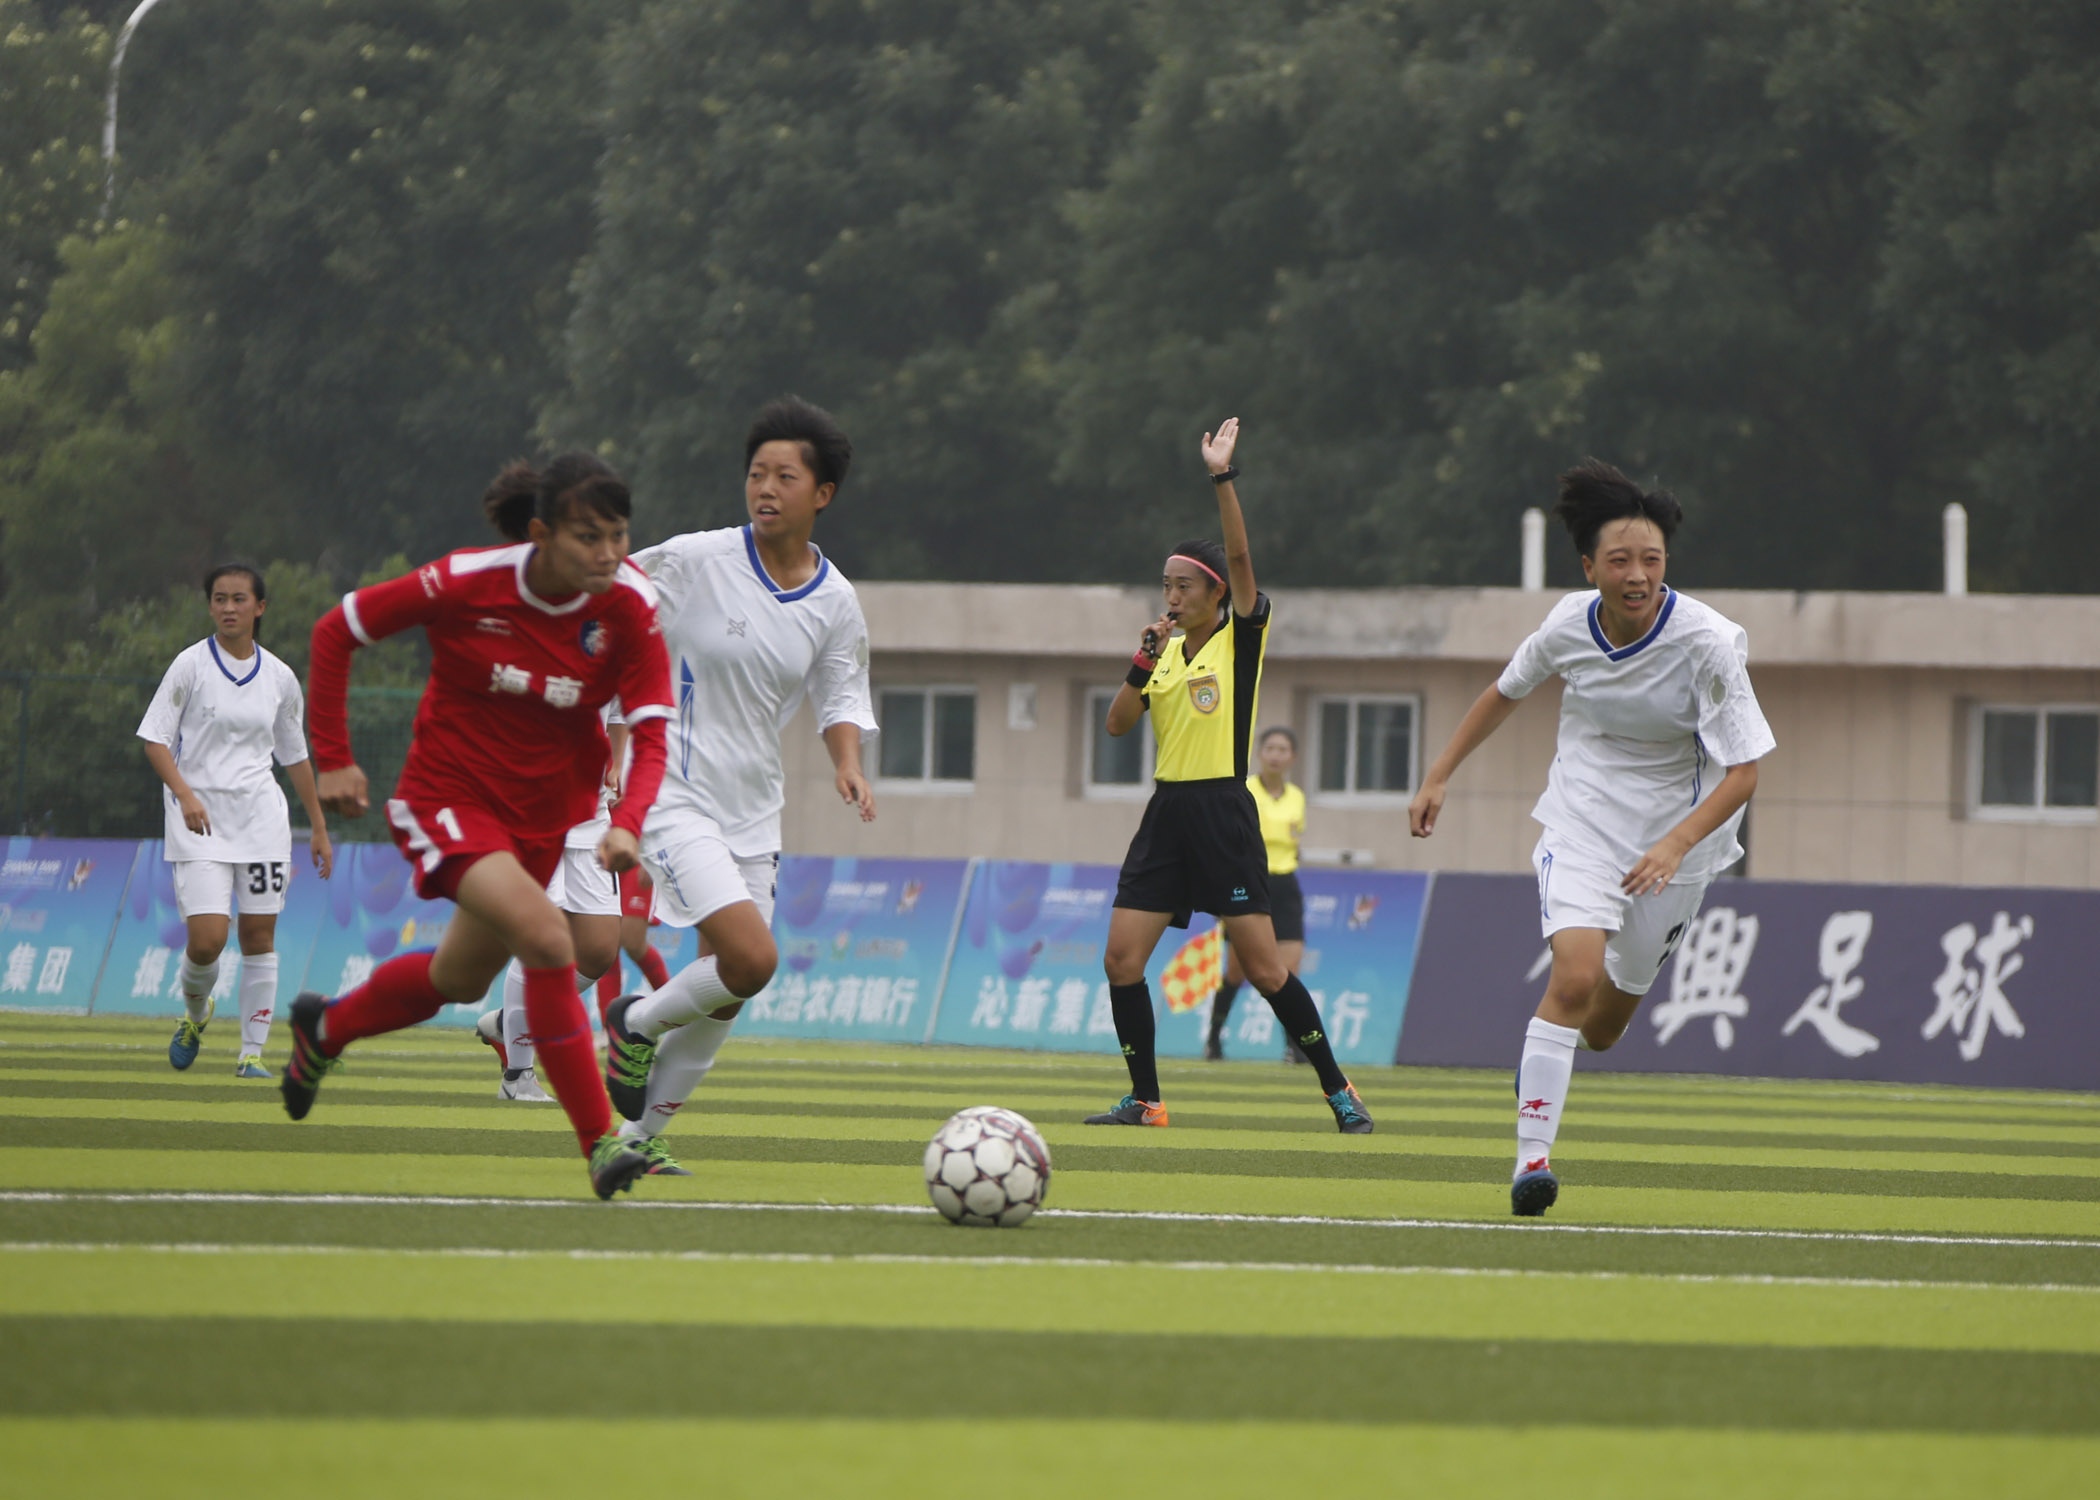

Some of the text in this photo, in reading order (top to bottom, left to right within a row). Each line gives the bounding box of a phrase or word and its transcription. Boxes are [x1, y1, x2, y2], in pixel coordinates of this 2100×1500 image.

[489, 662, 585, 708] 海南
[248, 862, 284, 894] 35
[1525, 906, 2035, 1062] 興足球
